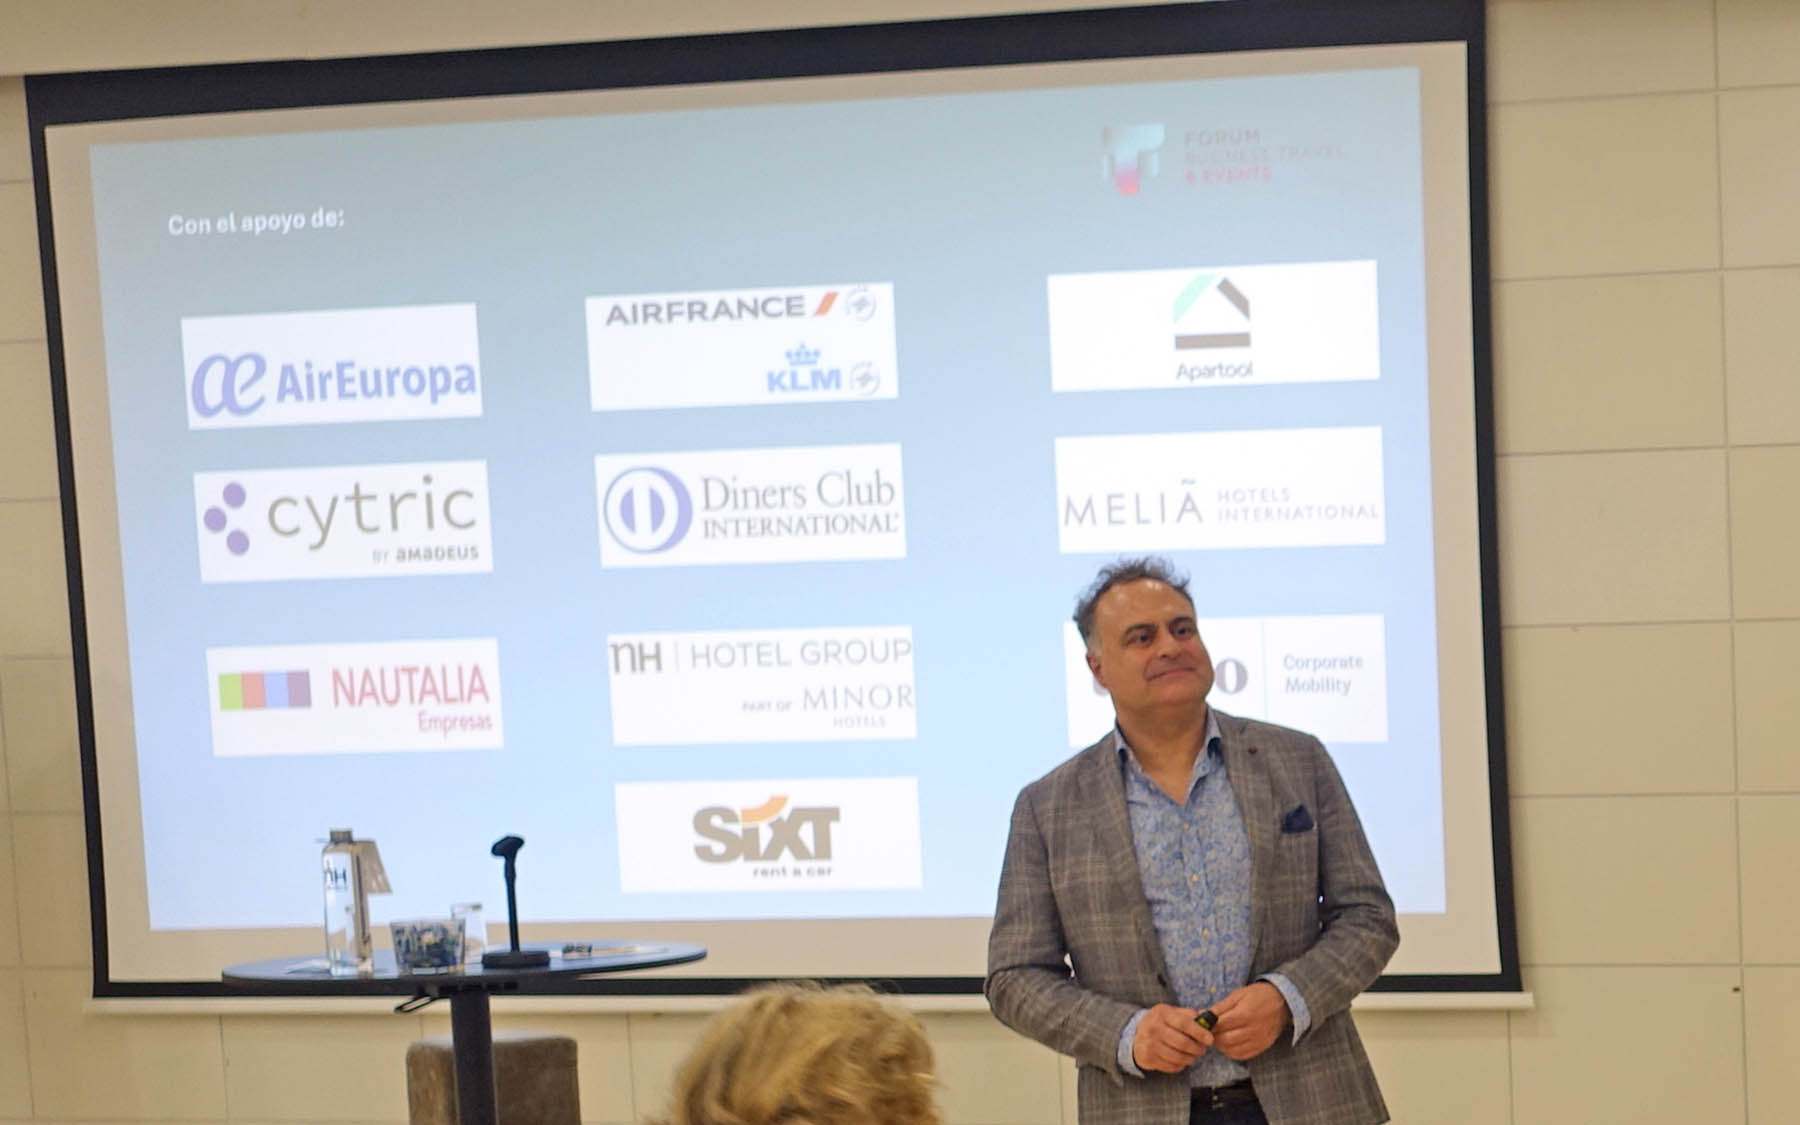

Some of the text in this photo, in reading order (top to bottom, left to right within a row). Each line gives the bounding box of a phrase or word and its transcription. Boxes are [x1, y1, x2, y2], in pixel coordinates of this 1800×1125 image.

[168, 205, 345, 236] Con el apoyo de:
[766, 368, 842, 393] KLM
[1176, 361, 1254, 382] Apartool
[701, 467, 896, 513] Diners Club
[1217, 488, 1291, 504] HOTELS
[268, 474, 476, 551] cytric
[1217, 504, 1380, 523] INTERNATIONAL
[703, 513, 898, 540] INTERNATIONAL
[691, 642, 793, 669] HOTEL
[800, 639, 913, 666] GROUP
[1284, 654, 1364, 672] Corporate
[331, 664, 490, 708] NAUTALIA
[803, 683, 914, 711] MINOR
[1285, 676, 1352, 696] Mobility
[417, 710, 493, 739] Empresas
[753, 867, 833, 878] rent a car
